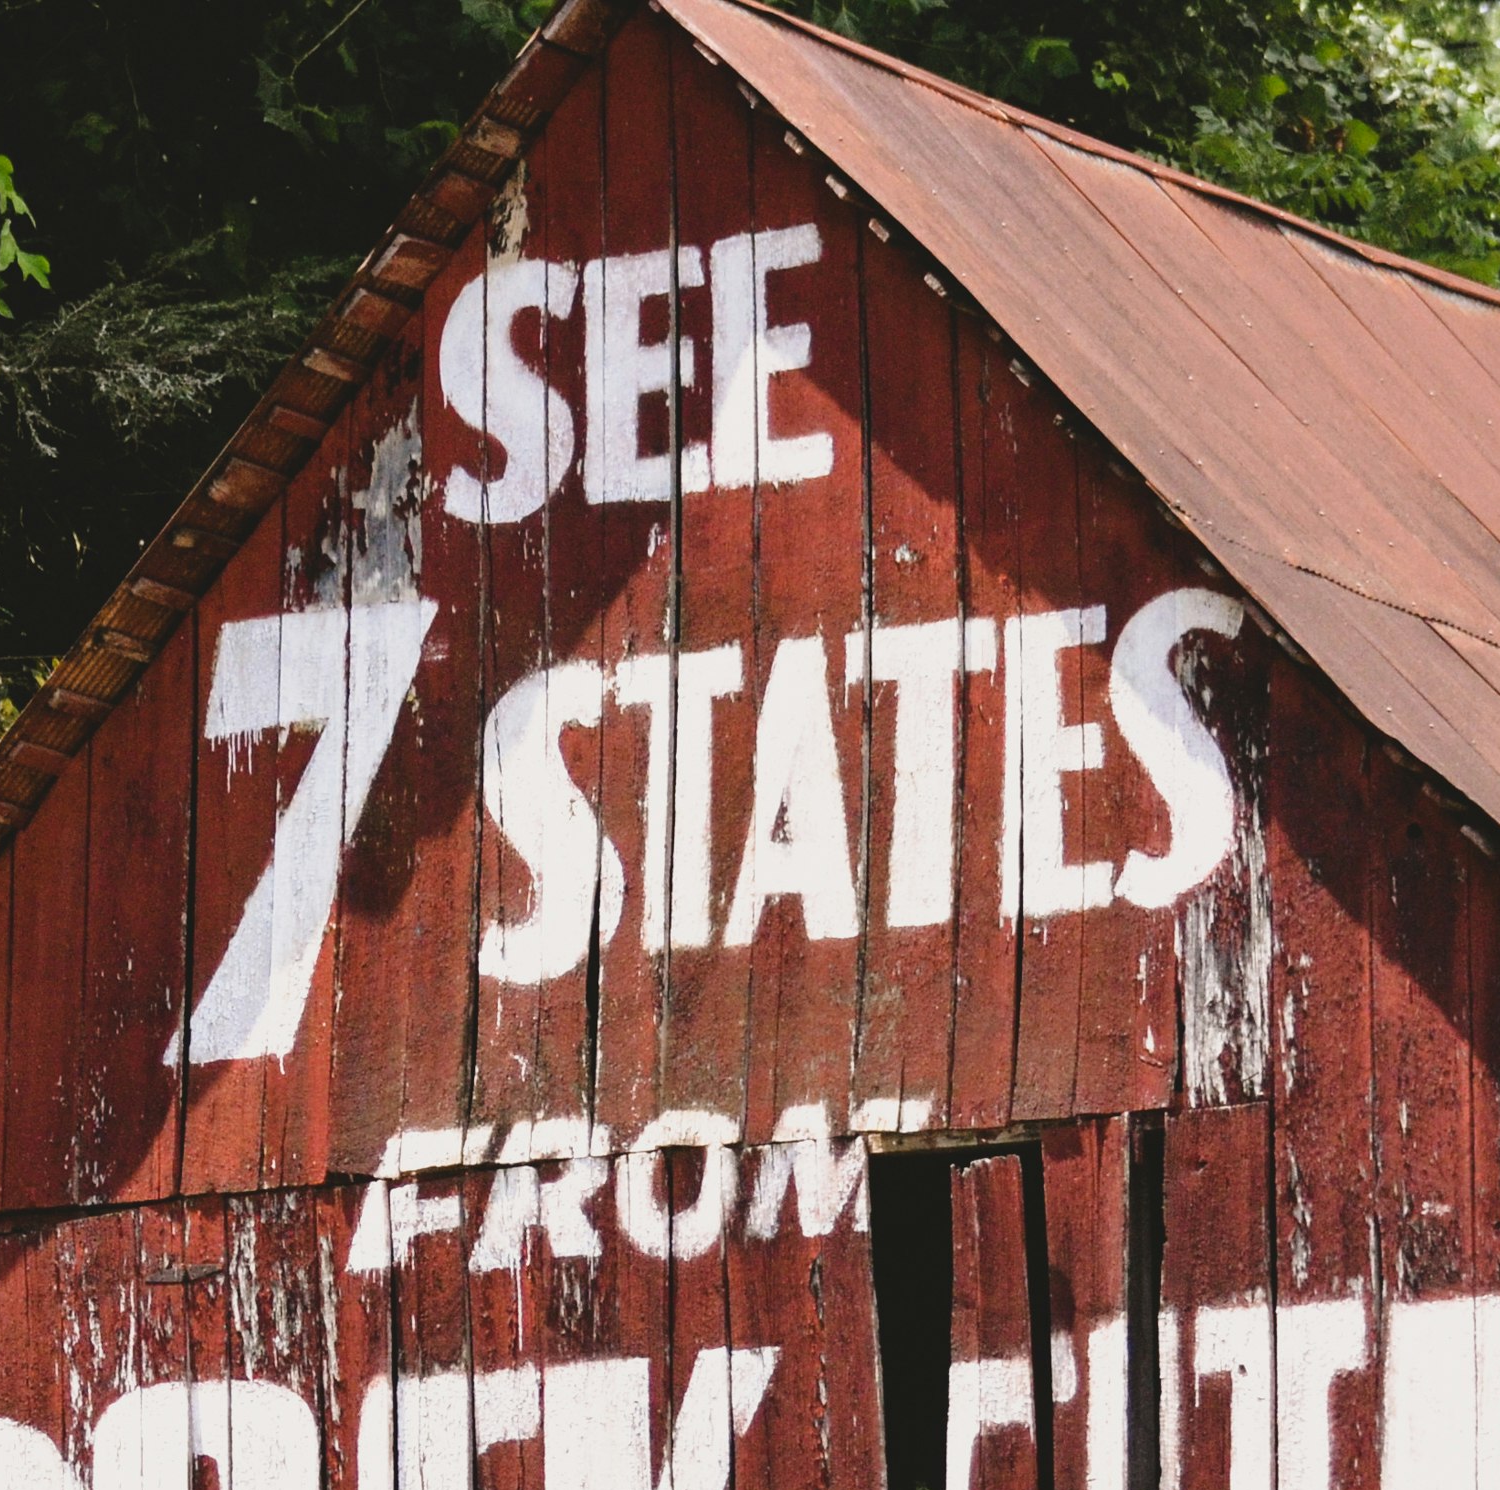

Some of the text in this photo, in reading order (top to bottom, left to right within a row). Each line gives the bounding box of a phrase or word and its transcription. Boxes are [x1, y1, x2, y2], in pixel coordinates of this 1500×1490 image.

[438, 222, 834, 524] SEE
[164, 587, 1247, 1069] 7 STATES
[345, 1097, 931, 1274] FROM
